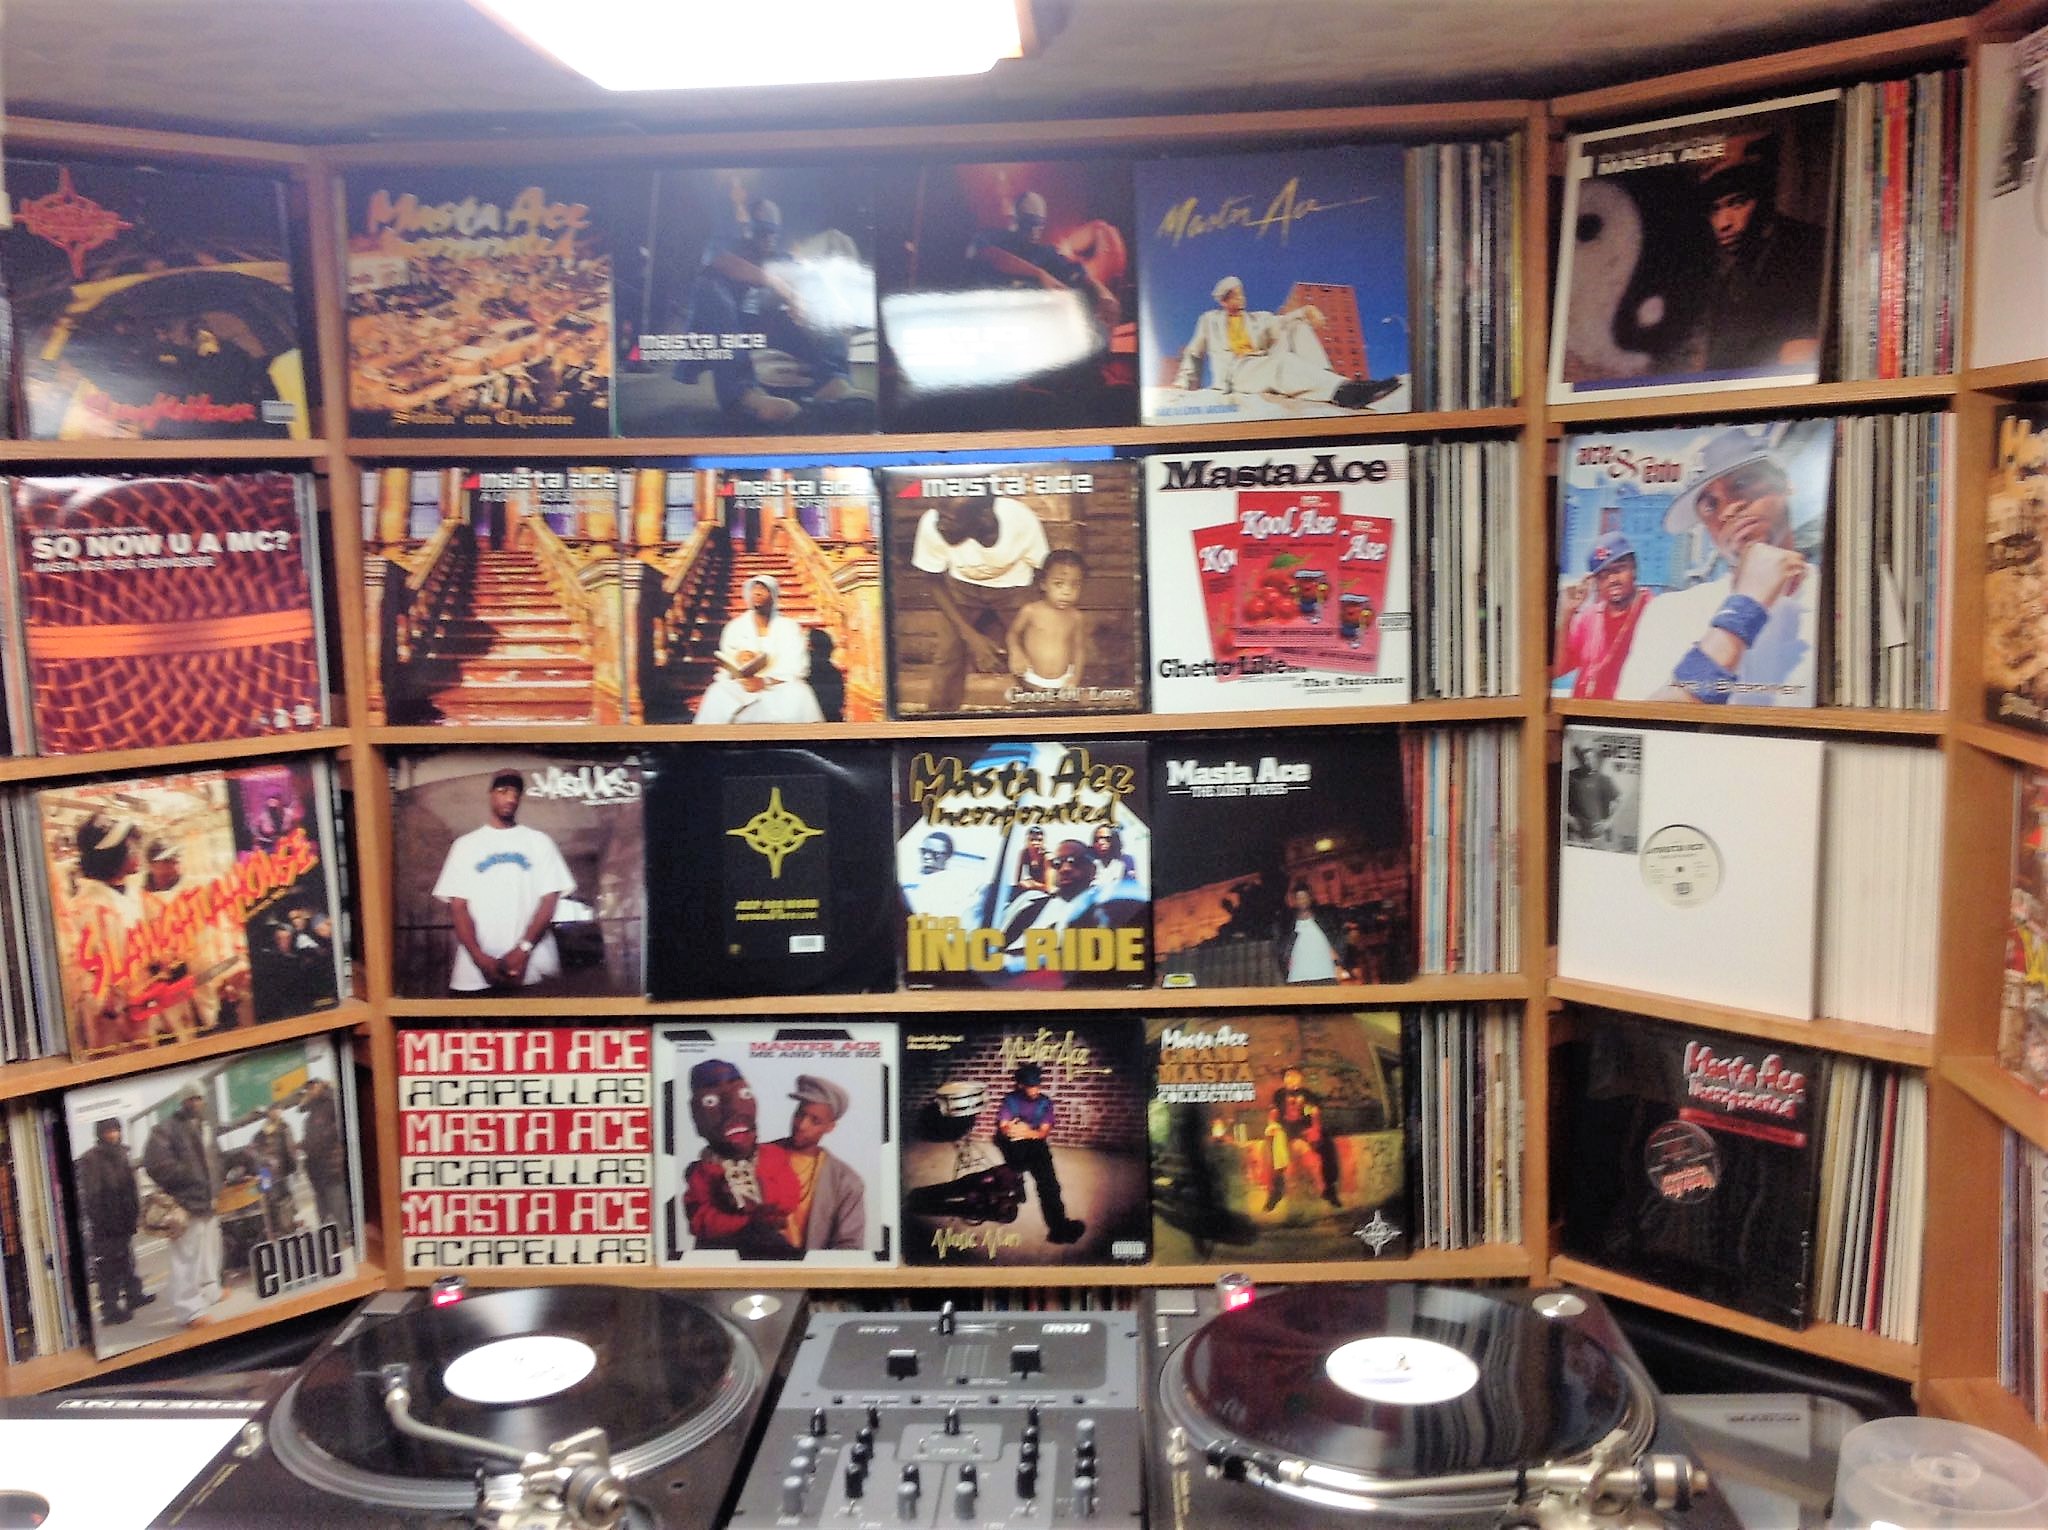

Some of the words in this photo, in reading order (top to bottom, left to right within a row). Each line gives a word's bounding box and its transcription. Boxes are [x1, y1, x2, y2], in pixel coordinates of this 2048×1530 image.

[1677, 142, 1726, 163] ACE
[368, 189, 498, 235] Masta
[505, 186, 591, 233] Ace
[638, 332, 718, 349] masta
[720, 333, 767, 349] ace
[480, 471, 565, 488] masta
[569, 473, 619, 488] ace
[735, 478, 817, 496] masta
[820, 480, 869, 495] ace
[921, 474, 1026, 498] masta
[1034, 473, 1094, 494] ace
[1159, 457, 1301, 491] Masta
[1302, 454, 1388, 483] Ace
[1240, 506, 1299, 540] Kool
[31, 537, 82, 560] SO
[85, 533, 164, 557] NOW
[168, 532, 193, 555] U
[198, 532, 223, 553] A
[225, 530, 292, 552] MC?
[1158, 657, 1233, 679] Ghetto
[1238, 654, 1288, 676] Like
[1303, 678, 1331, 688] The
[1334, 676, 1405, 686] Outcome
[908, 752, 1040, 802] Masta
[1051, 746, 1136, 796] Ace
[1166, 760, 1254, 786] Masta
[1256, 756, 1312, 783] Ace
[921, 793, 1122, 837] Incorporated
[906, 912, 962, 930] the
[1024, 928, 1146, 972] RIDE
[403, 1031, 555, 1073] MASTA
[567, 1030, 648, 1071] ACE
[750, 1041, 834, 1051] MASTER
[841, 1041, 881, 1051] ACE
[1160, 1027, 1215, 1050] Masta
[1215, 1025, 1249, 1048] Ace
[1157, 1063, 1254, 1084] MASTA
[1683, 1041, 1758, 1090] Masta
[1754, 1053, 1807, 1098] Ace
[407, 1077, 646, 1107] ACAPELLAS
[406, 1111, 556, 1154] MASTA
[568, 1111, 648, 1151] ACE
[410, 1158, 646, 1187] ACAPELLAS
[406, 1192, 557, 1234] MASTA
[569, 1191, 648, 1232] ACE
[254, 1223, 342, 1299] emc
[413, 1238, 647, 1267] ACAPELLAS
